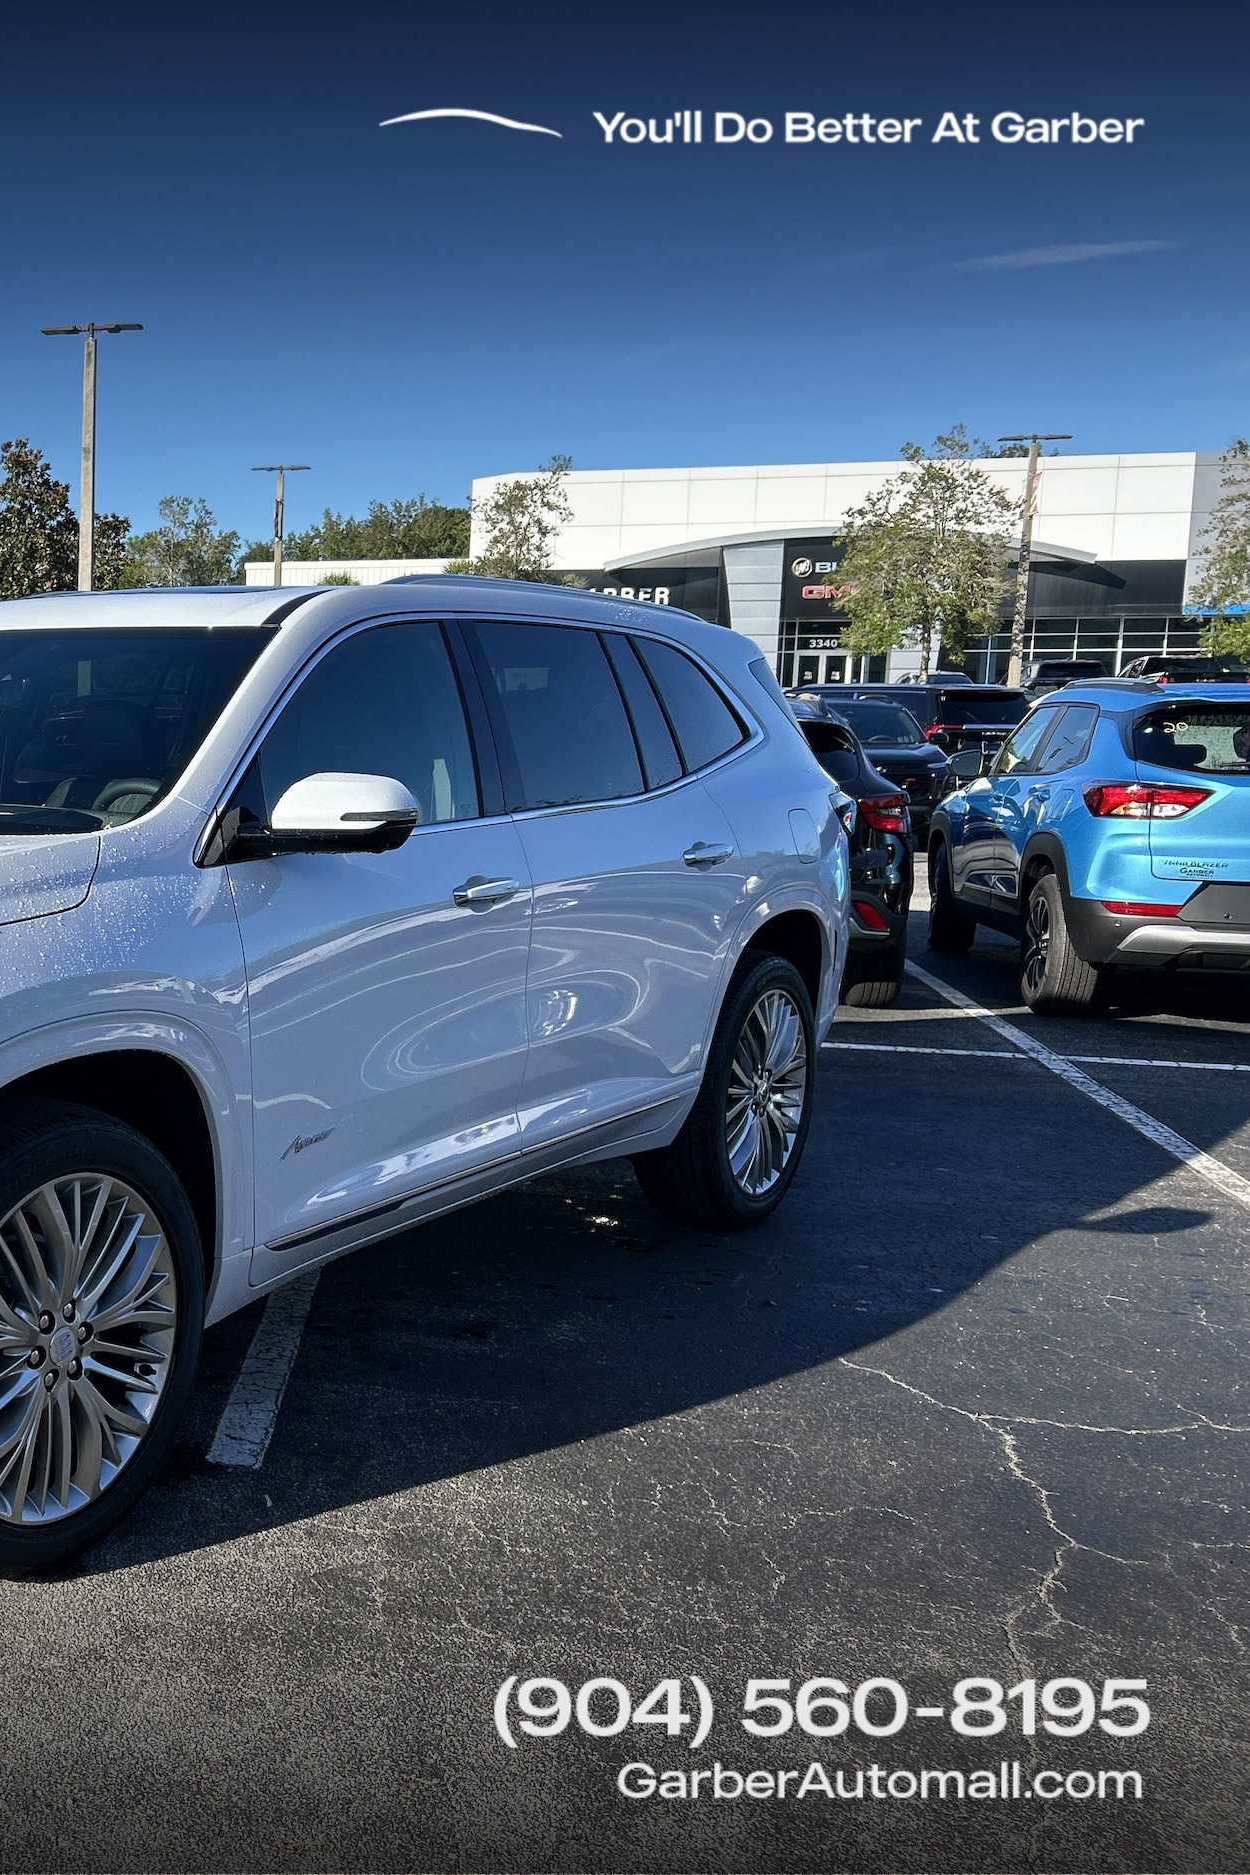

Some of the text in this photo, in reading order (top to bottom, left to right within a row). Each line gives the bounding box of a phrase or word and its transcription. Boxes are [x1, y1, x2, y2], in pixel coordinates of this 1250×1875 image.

[802, 585, 858, 599] GM
[808, 639, 838, 649] 3340
[1163, 722, 1189, 734] 20
